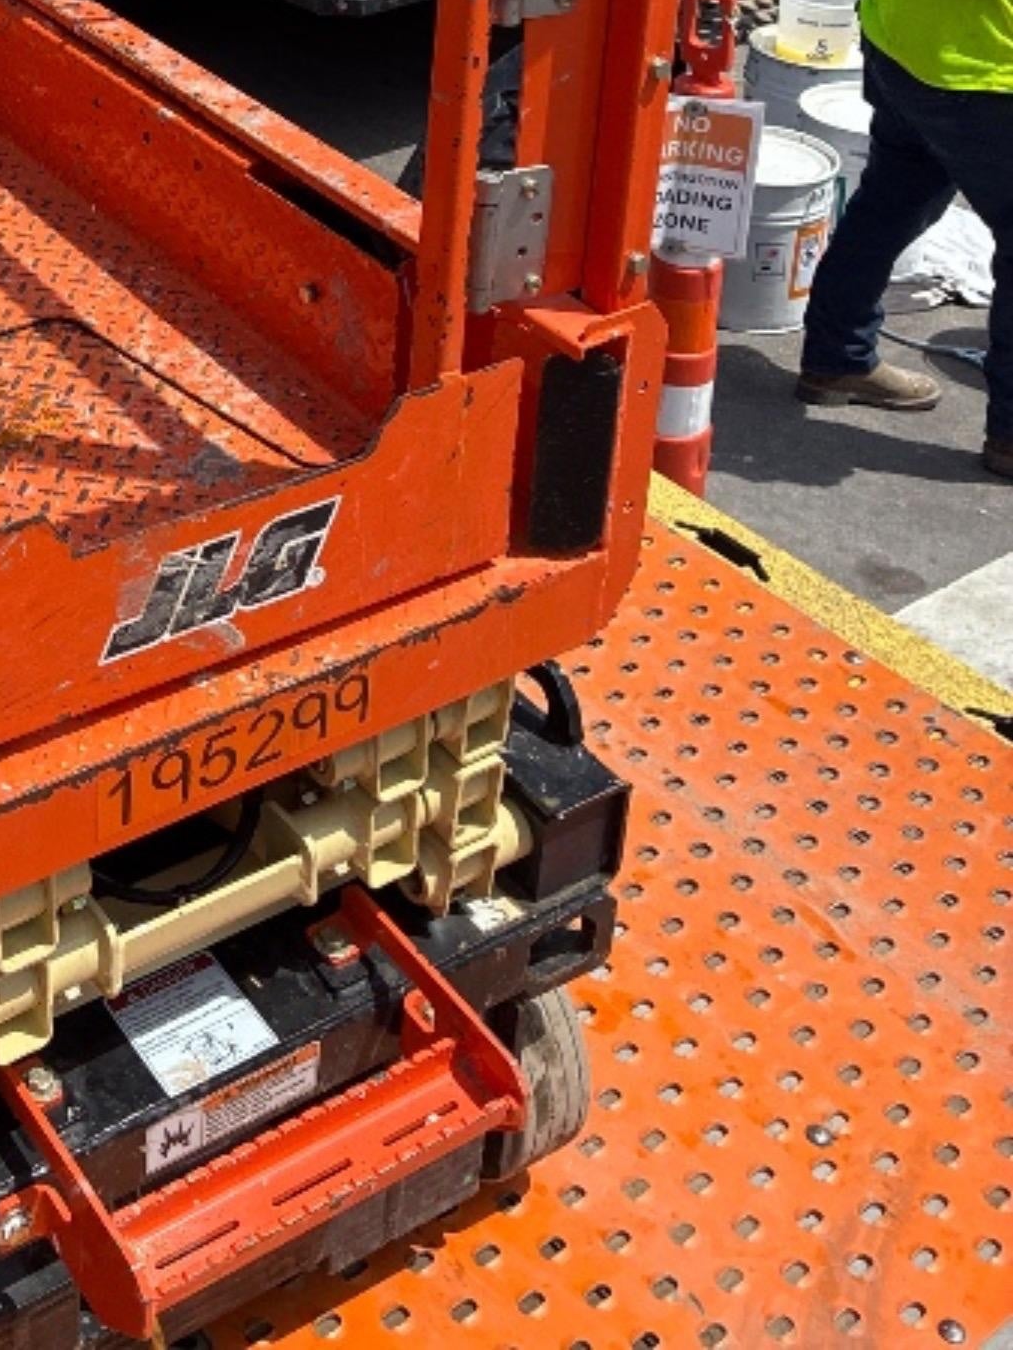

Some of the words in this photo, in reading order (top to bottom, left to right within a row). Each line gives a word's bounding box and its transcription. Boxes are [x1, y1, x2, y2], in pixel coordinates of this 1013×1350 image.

[673, 116, 711, 134] NO
[661, 141, 743, 165] RKING
[655, 188, 732, 211] ADING
[98, 495, 342, 666] JLG
[108, 673, 370, 826] 195299
